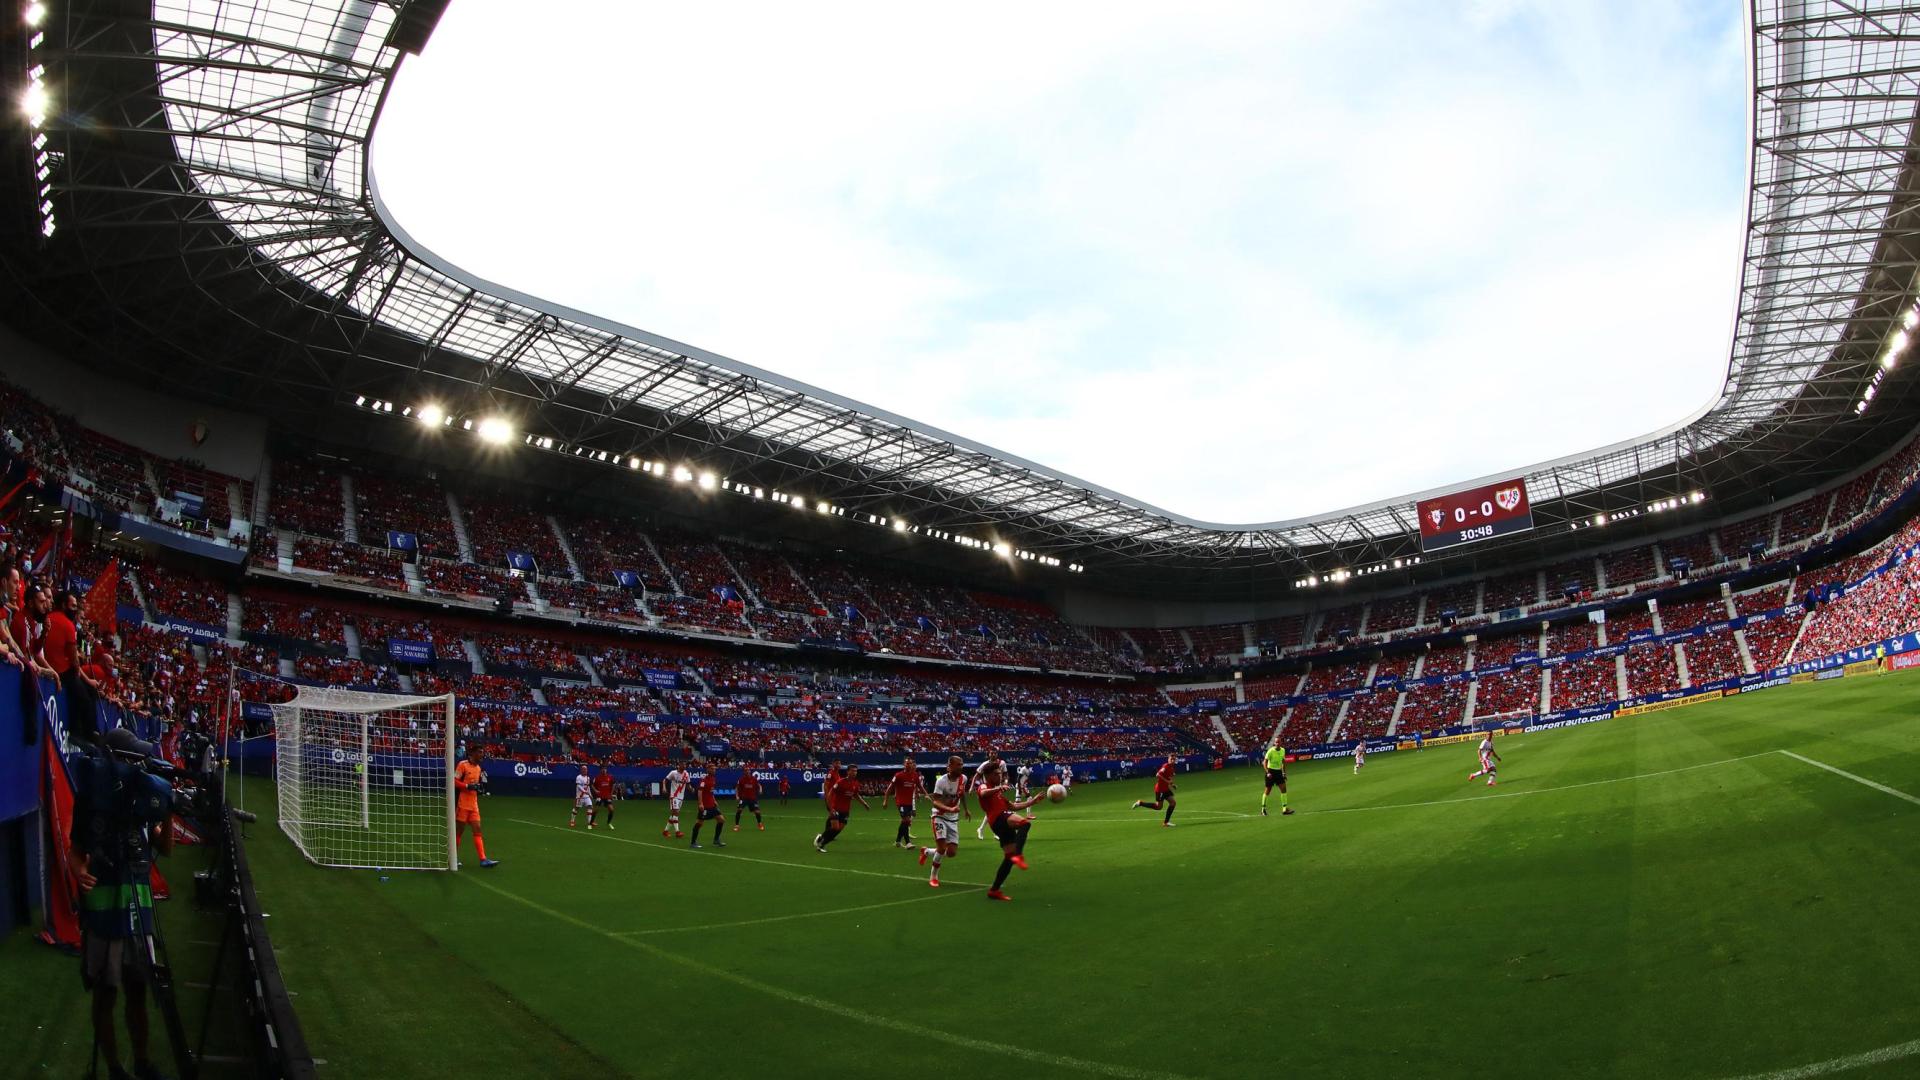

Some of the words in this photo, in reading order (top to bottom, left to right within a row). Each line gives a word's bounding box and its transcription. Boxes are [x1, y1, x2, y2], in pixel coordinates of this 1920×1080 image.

[1454, 508, 1465, 523] 0
[1481, 501, 1493, 517] 0
[1460, 525, 1493, 542] 30:48
[172, 623, 194, 634] GRUPO
[404, 650, 429, 659] NAVARRA
[1644, 699, 1680, 712] especialistas
[760, 772, 780, 780] SELK
